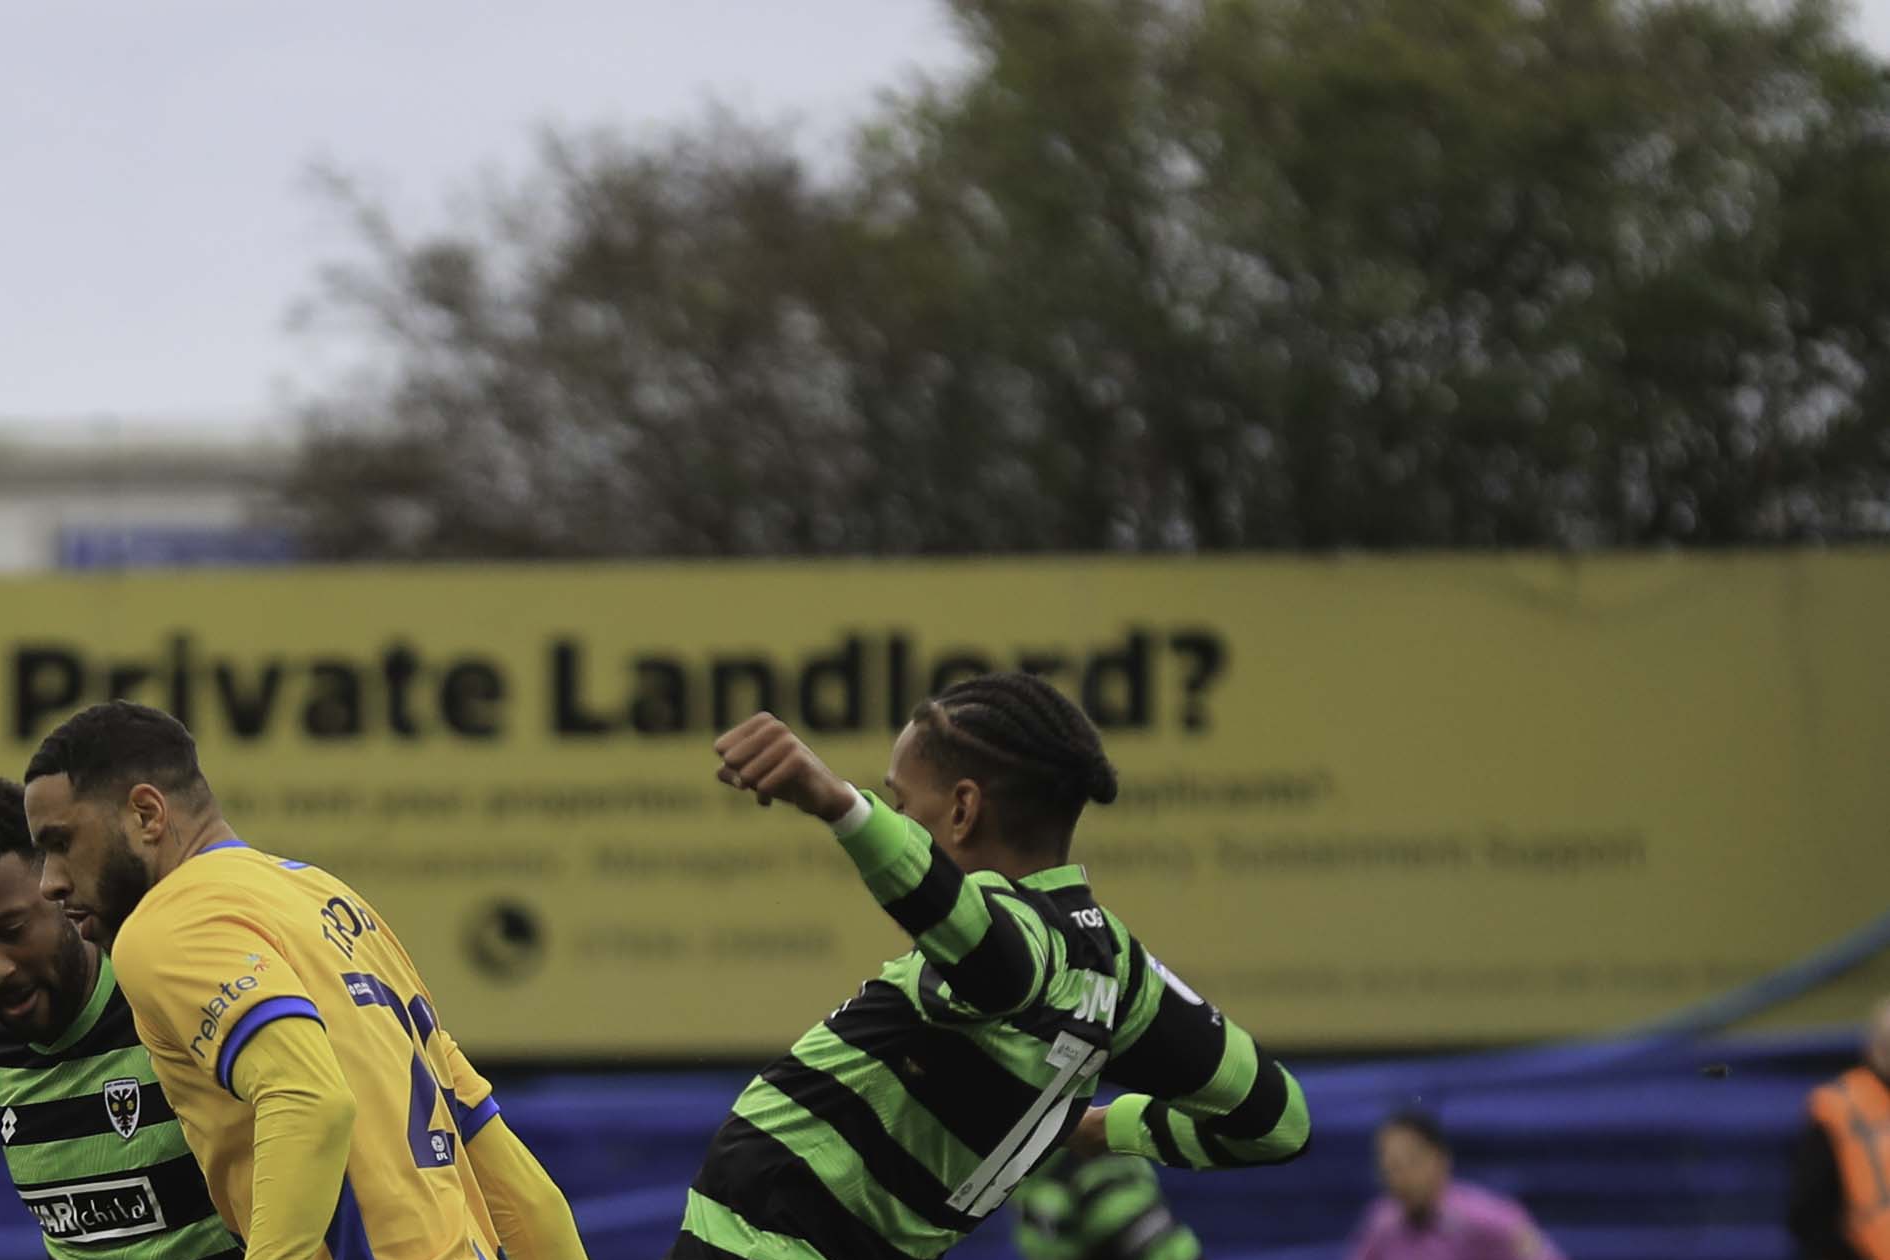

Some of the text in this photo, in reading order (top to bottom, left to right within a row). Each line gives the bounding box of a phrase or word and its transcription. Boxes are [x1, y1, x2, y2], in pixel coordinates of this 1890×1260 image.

[3, 630, 510, 742] Private
[190, 975, 258, 1059] relate
[80, 1194, 149, 1227] child
